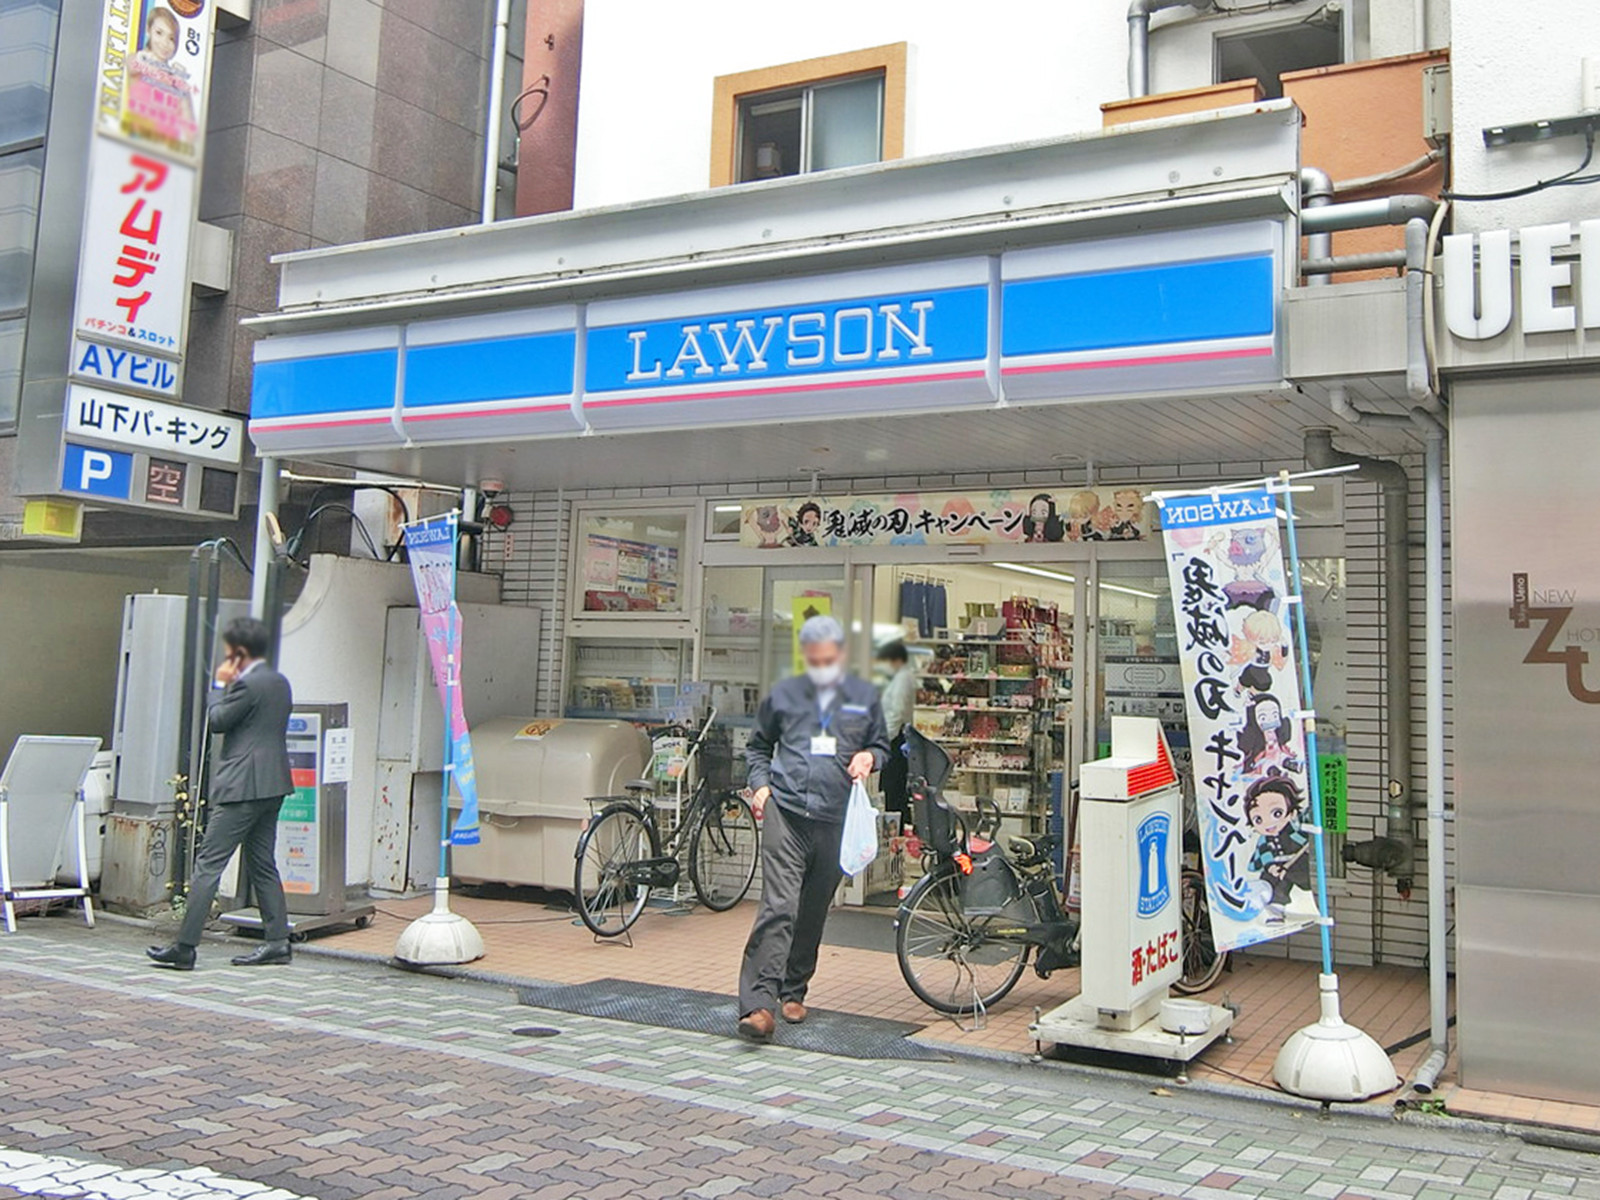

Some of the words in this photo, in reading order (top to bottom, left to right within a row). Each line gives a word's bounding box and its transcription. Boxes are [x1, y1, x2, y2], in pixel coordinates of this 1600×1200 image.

[187, 27, 201, 42] B1
[112, 153, 171, 323] アムディ
[1442, 218, 1600, 341] UE
[626, 300, 934, 382] LAWSON
[78, 344, 176, 390] AYビル
[79, 399, 232, 451] 山下パーキング
[79, 449, 113, 490] P
[147, 464, 182, 504] 空
[1533, 589, 1577, 604] NEW
